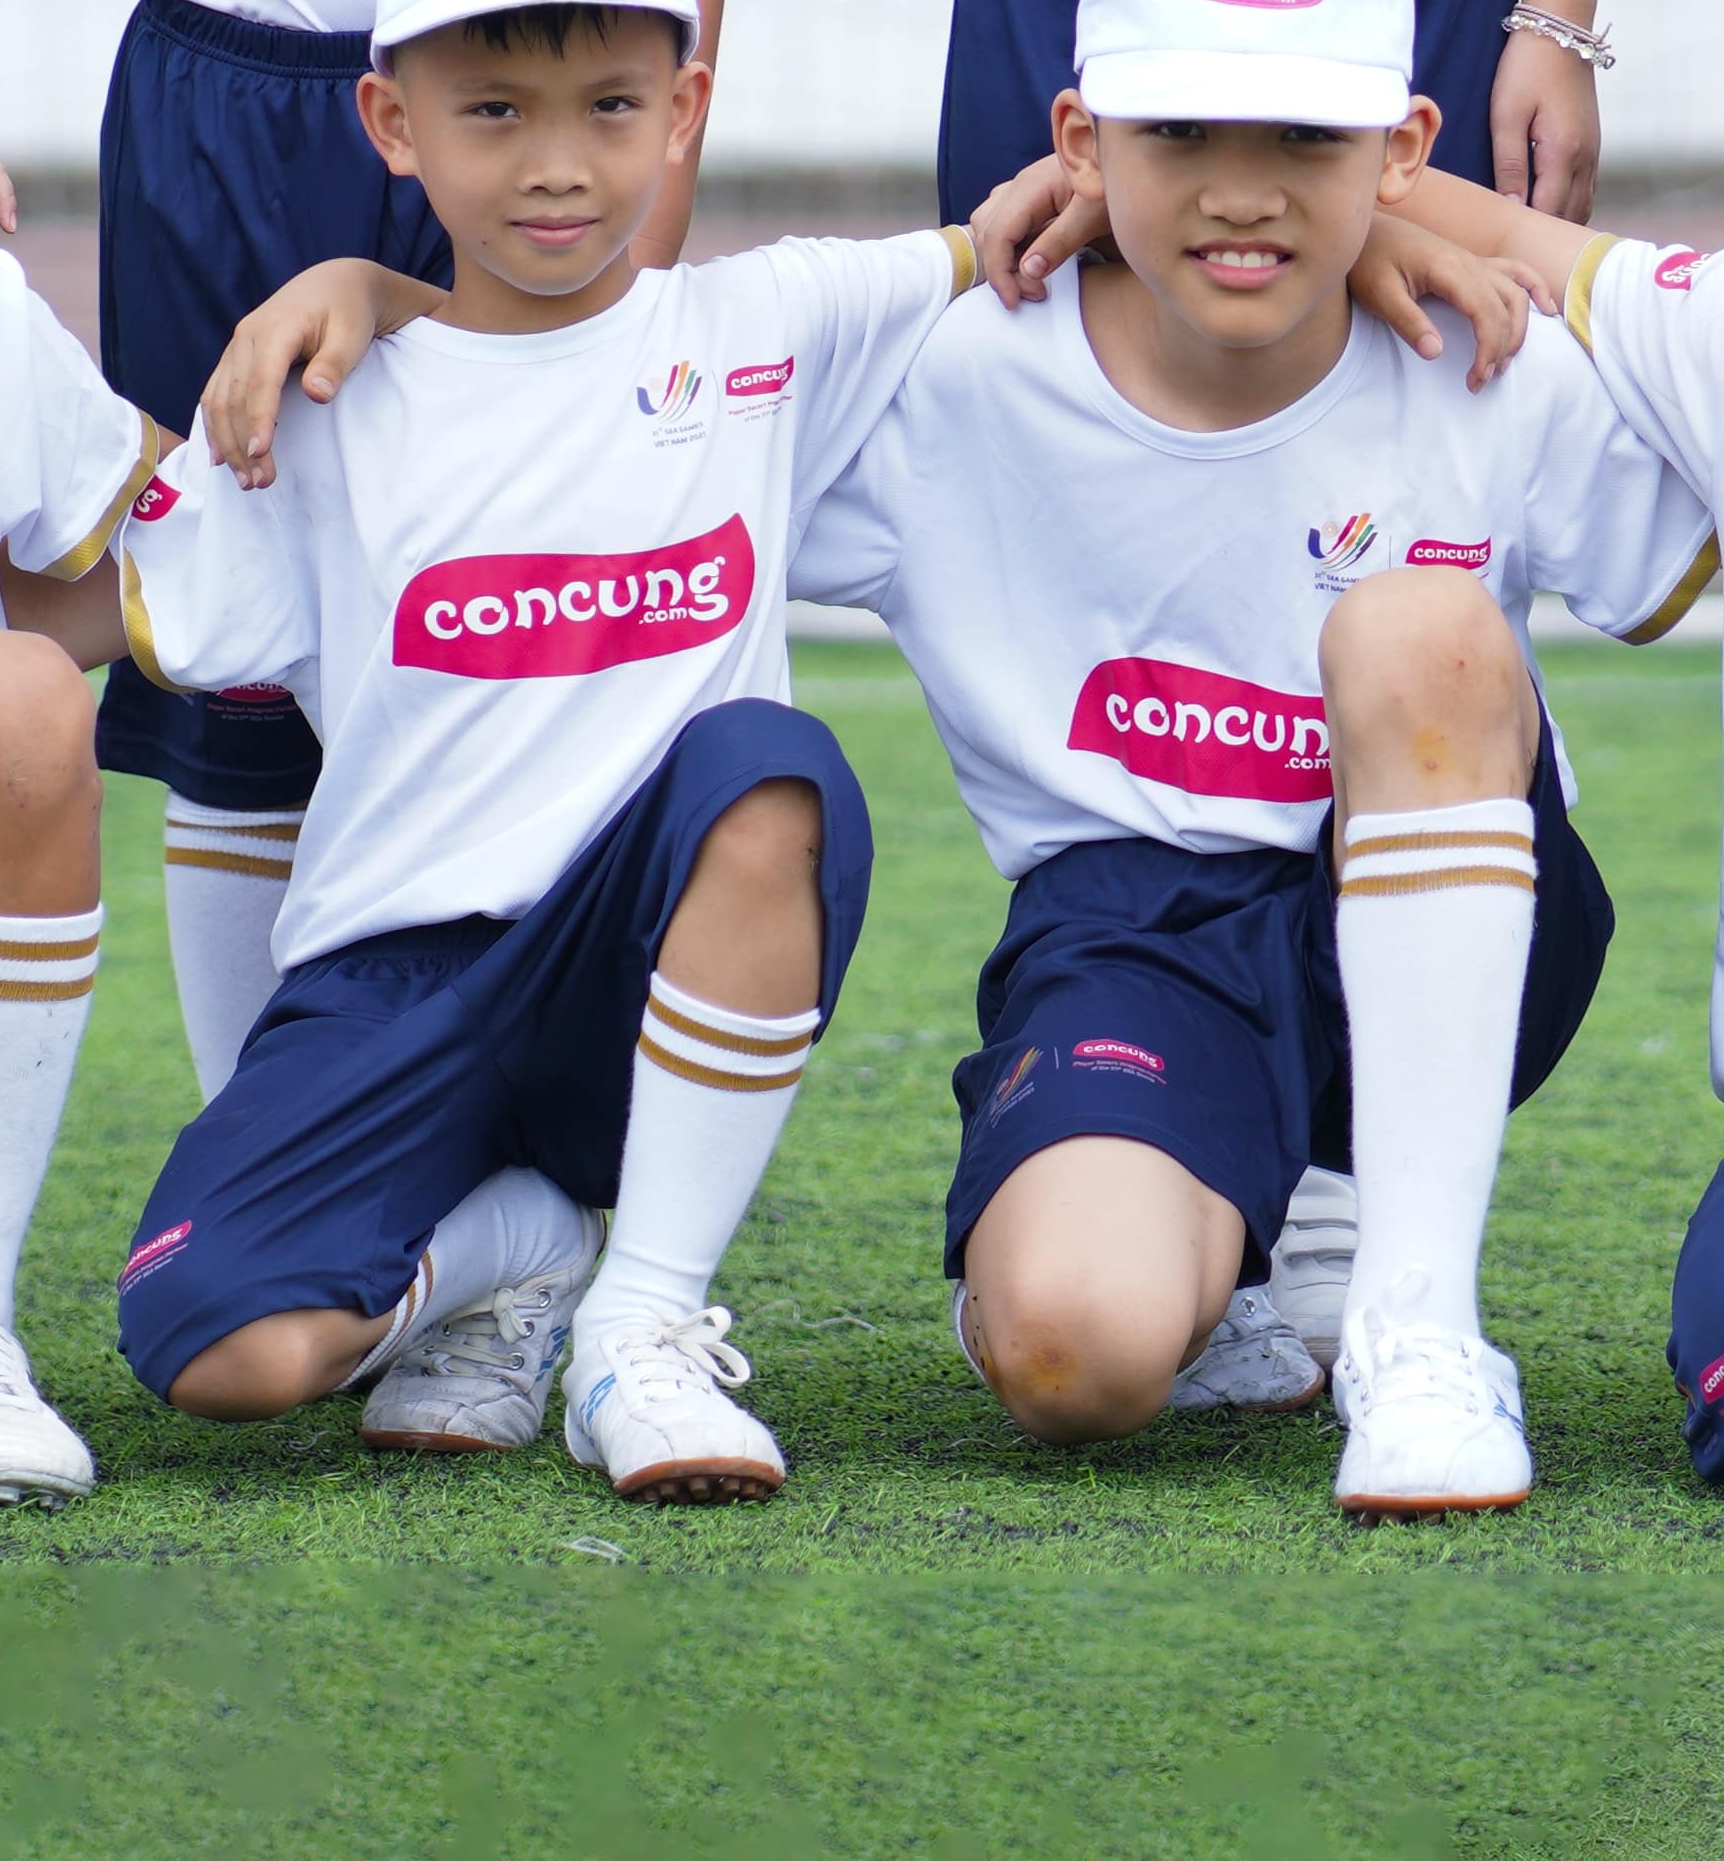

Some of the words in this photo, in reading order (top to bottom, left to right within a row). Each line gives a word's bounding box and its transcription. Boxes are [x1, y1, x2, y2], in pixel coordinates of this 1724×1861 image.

[1413, 545, 1488, 563] concung
[424, 555, 729, 640] concung
[638, 606, 688, 626] .com
[1105, 693, 1330, 756] concun
[1083, 1044, 1158, 1068] concung
